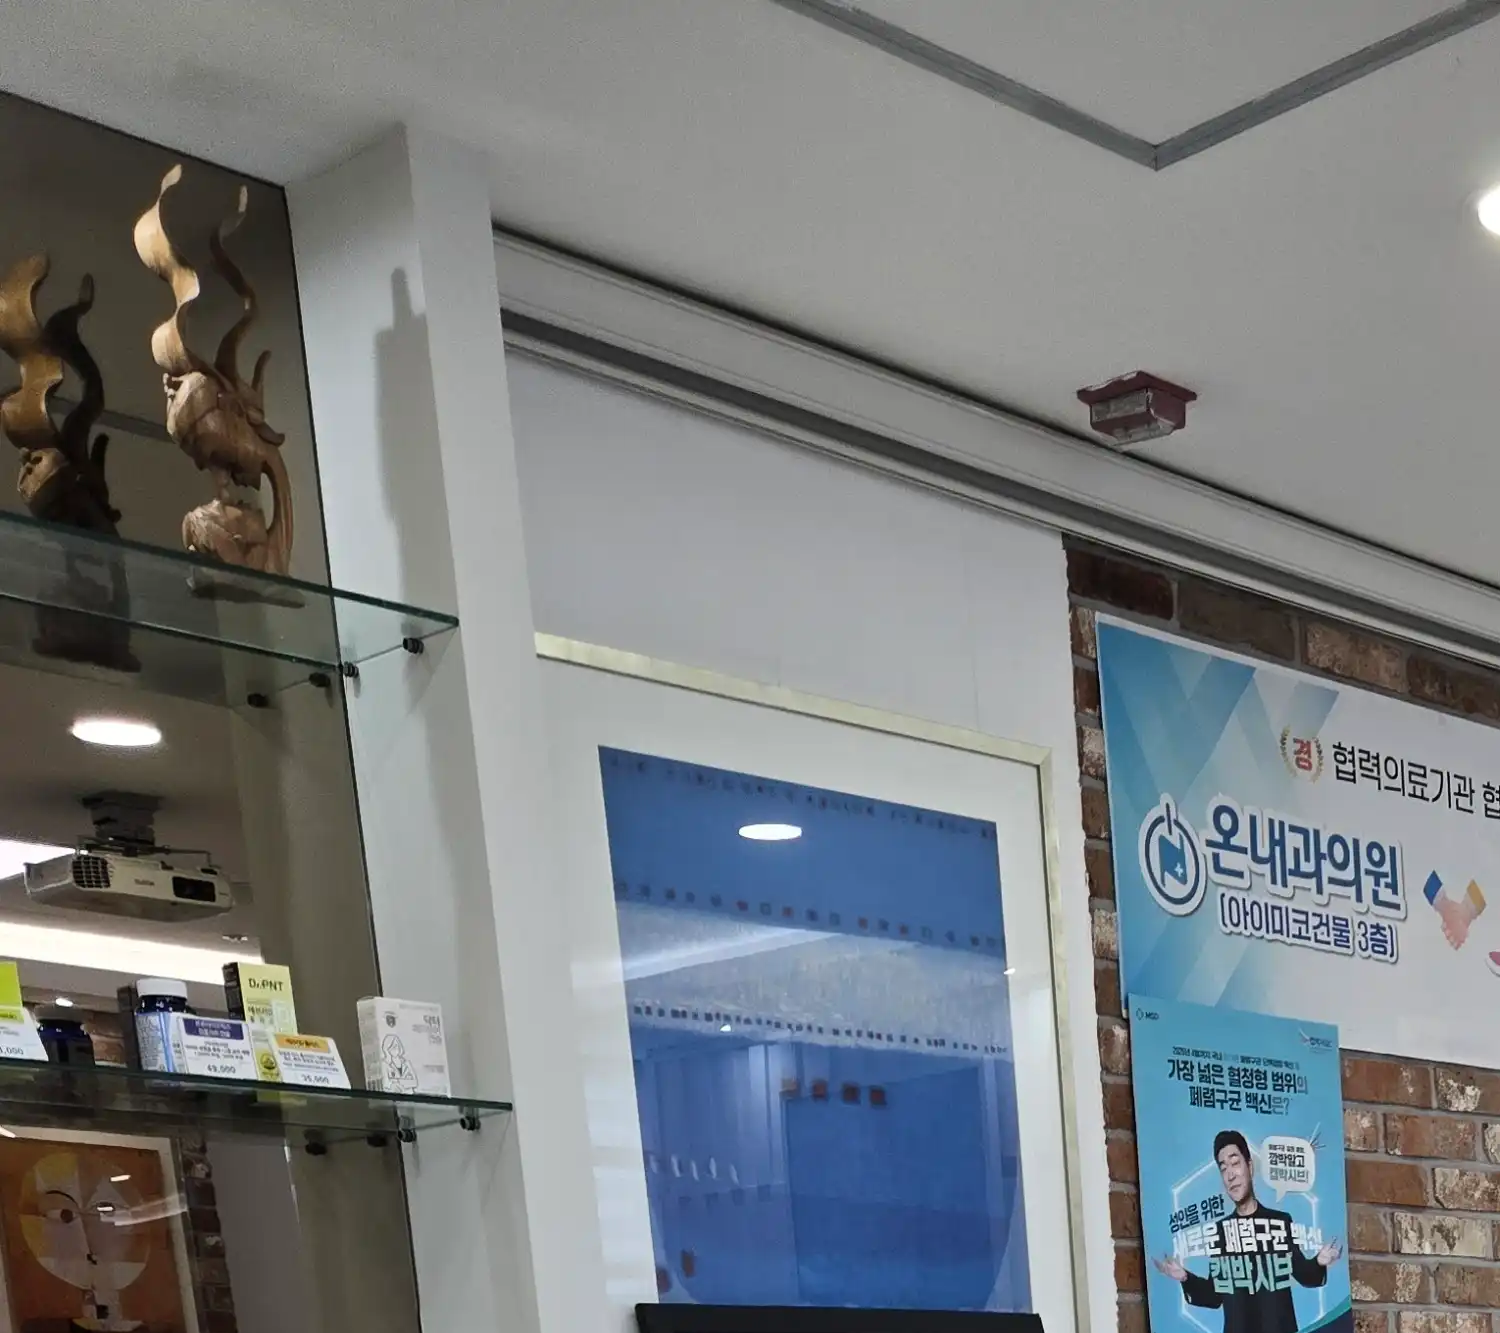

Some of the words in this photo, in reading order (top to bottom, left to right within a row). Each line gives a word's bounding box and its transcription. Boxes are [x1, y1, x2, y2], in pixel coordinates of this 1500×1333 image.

[1293, 738, 1313, 772] 경
[1332, 741, 1475, 814] 협력의료기관
[1205, 804, 1402, 911] 온내과의원
[1219, 892, 1351, 949] (아이미코건물
[1357, 921, 1395, 958] 3층)
[1167, 1058, 1194, 1081] 가장
[1197, 1061, 1224, 1086] 넓은
[1227, 1065, 1268, 1091] 혈청형
[1271, 1071, 1308, 1095] 범위의
[1189, 1085, 1242, 1112] 폐렴구균
[1244, 1091, 1290, 1116] 백신은?
[1169, 1203, 1201, 1234] 성인을
[1200, 1193, 1226, 1220] 위한
[1222, 1218, 1289, 1253] 폐렴구균
[1290, 1221, 1323, 1252] 백신
[1209, 1251, 1294, 1295] 캡박시브
